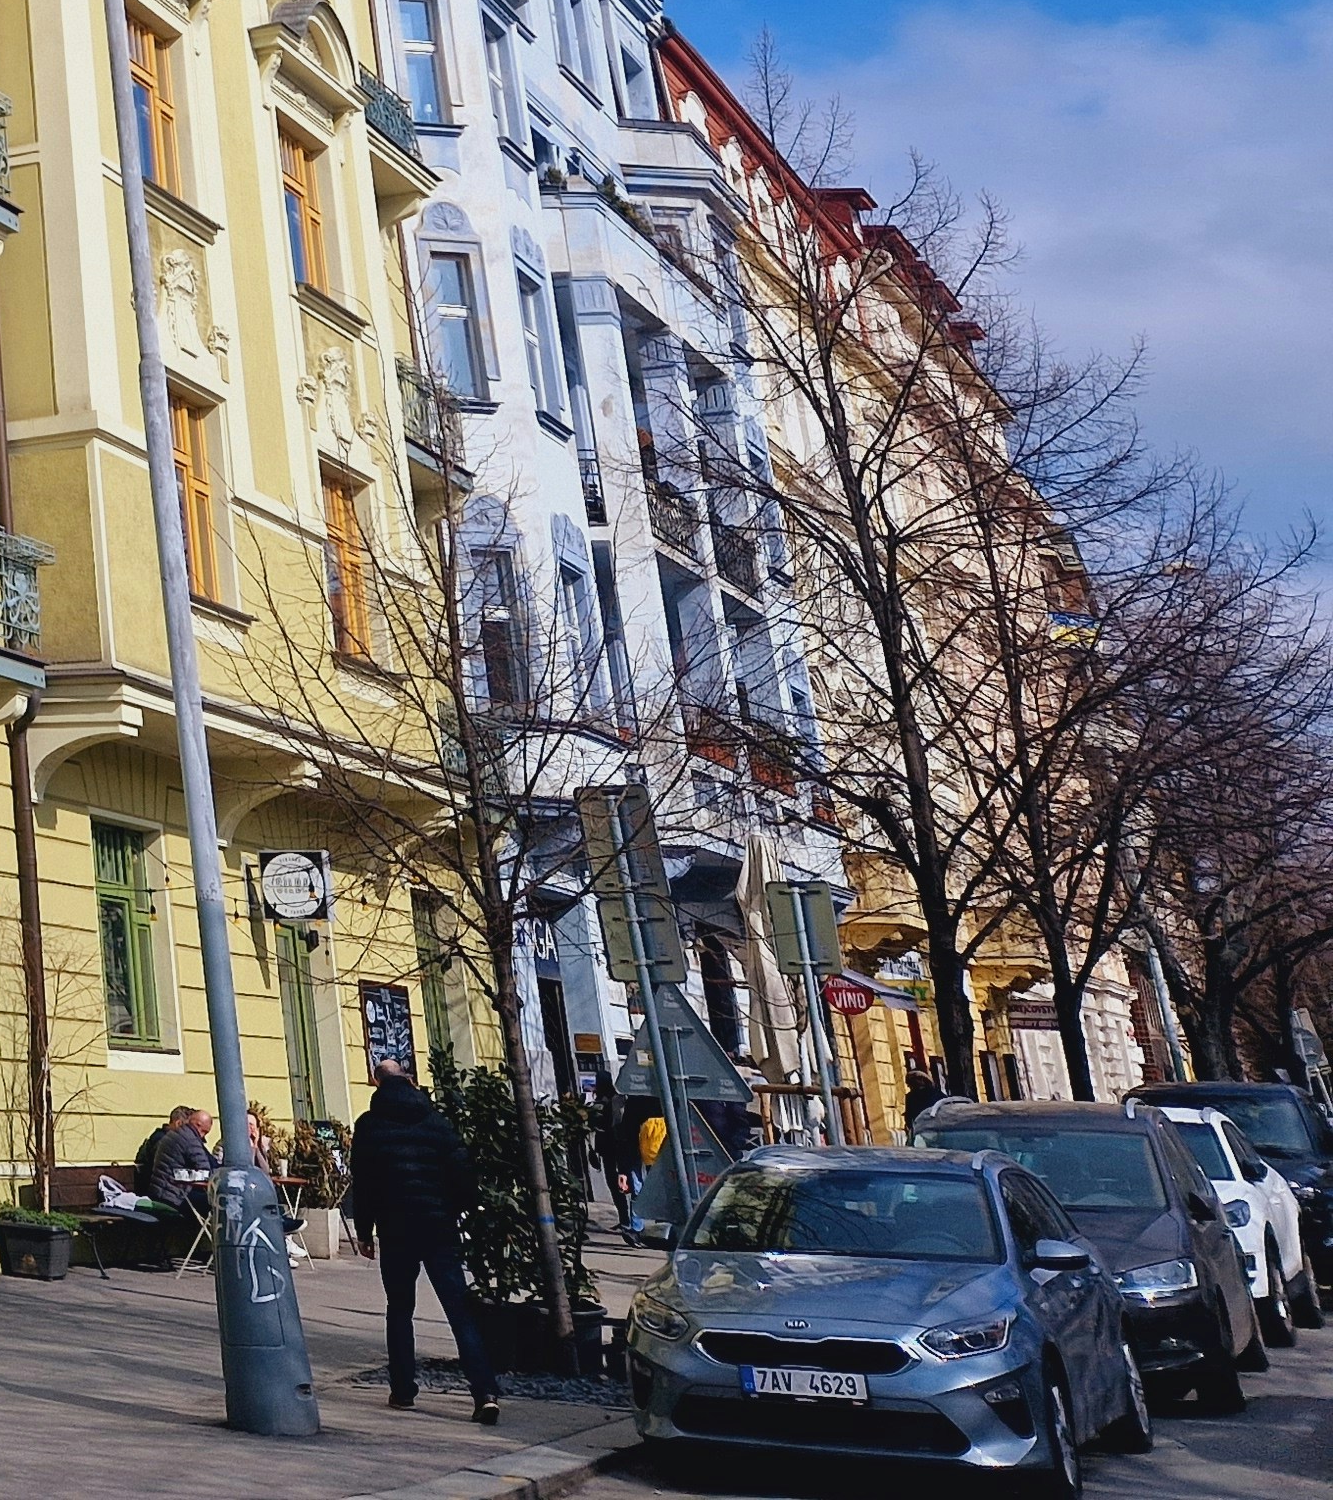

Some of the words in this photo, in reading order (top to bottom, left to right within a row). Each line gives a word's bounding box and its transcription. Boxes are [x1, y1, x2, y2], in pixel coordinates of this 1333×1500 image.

[833, 989, 867, 1009] VÍNO
[787, 1320, 806, 1328] KIA
[756, 1370, 792, 1392] 7AV
[809, 1373, 858, 1396] 4629
